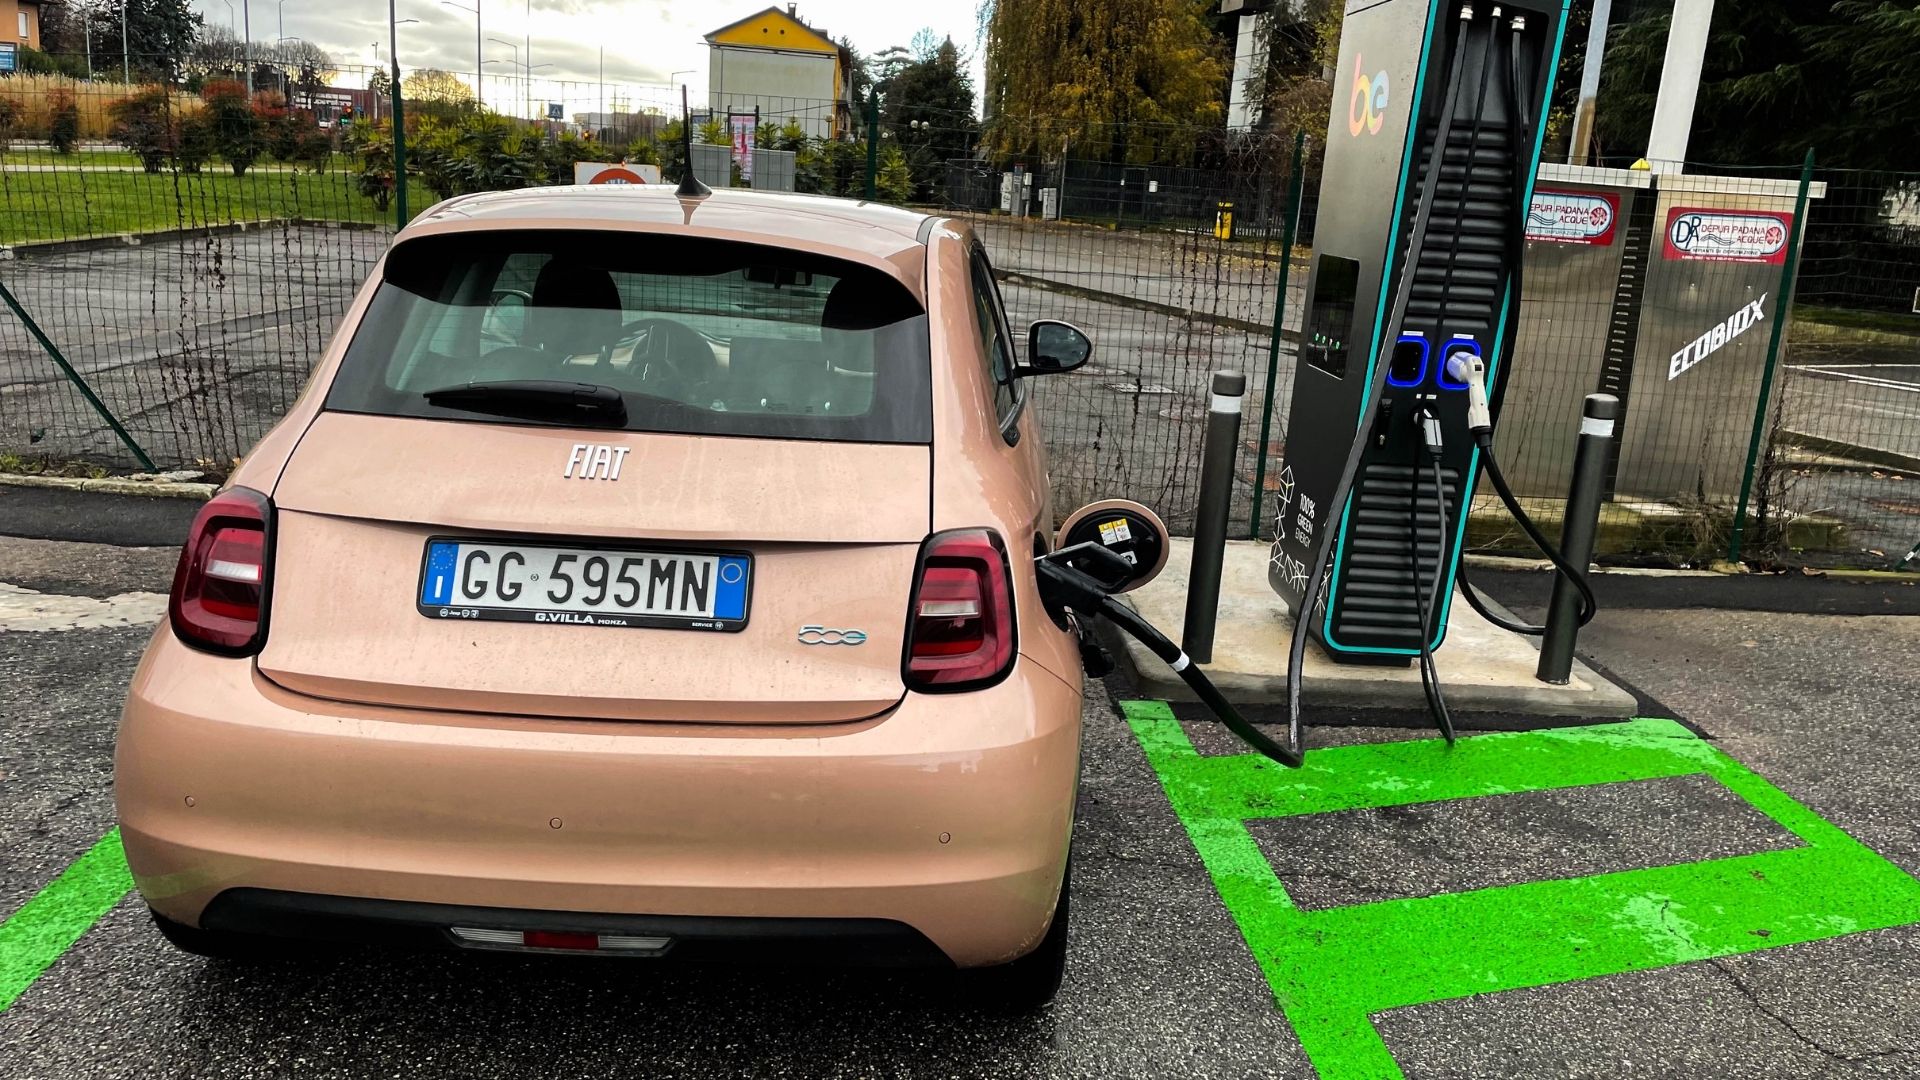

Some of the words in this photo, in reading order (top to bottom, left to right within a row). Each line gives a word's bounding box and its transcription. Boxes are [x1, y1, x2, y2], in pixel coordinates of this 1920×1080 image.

[1349, 53, 1389, 136] be
[1530, 203, 1553, 213] EPUR
[1555, 205, 1589, 216] PADANA
[1558, 215, 1588, 225] ACQUE
[1701, 224, 1730, 234] DEPUR
[1732, 225, 1766, 235] PADANA
[1736, 235, 1765, 245] ACQUE
[1667, 291, 1768, 381] ECOBIOX
[563, 444, 631, 481] FIAT
[1300, 493, 1316, 519] 100%
[1297, 513, 1313, 535] GREEN
[1295, 527, 1311, 548] ENERGY
[461, 550, 525, 602] GG
[547, 553, 711, 612] 595MN
[534, 612, 595, 625] G.VILLA
[597, 618, 628, 626] MONZA
